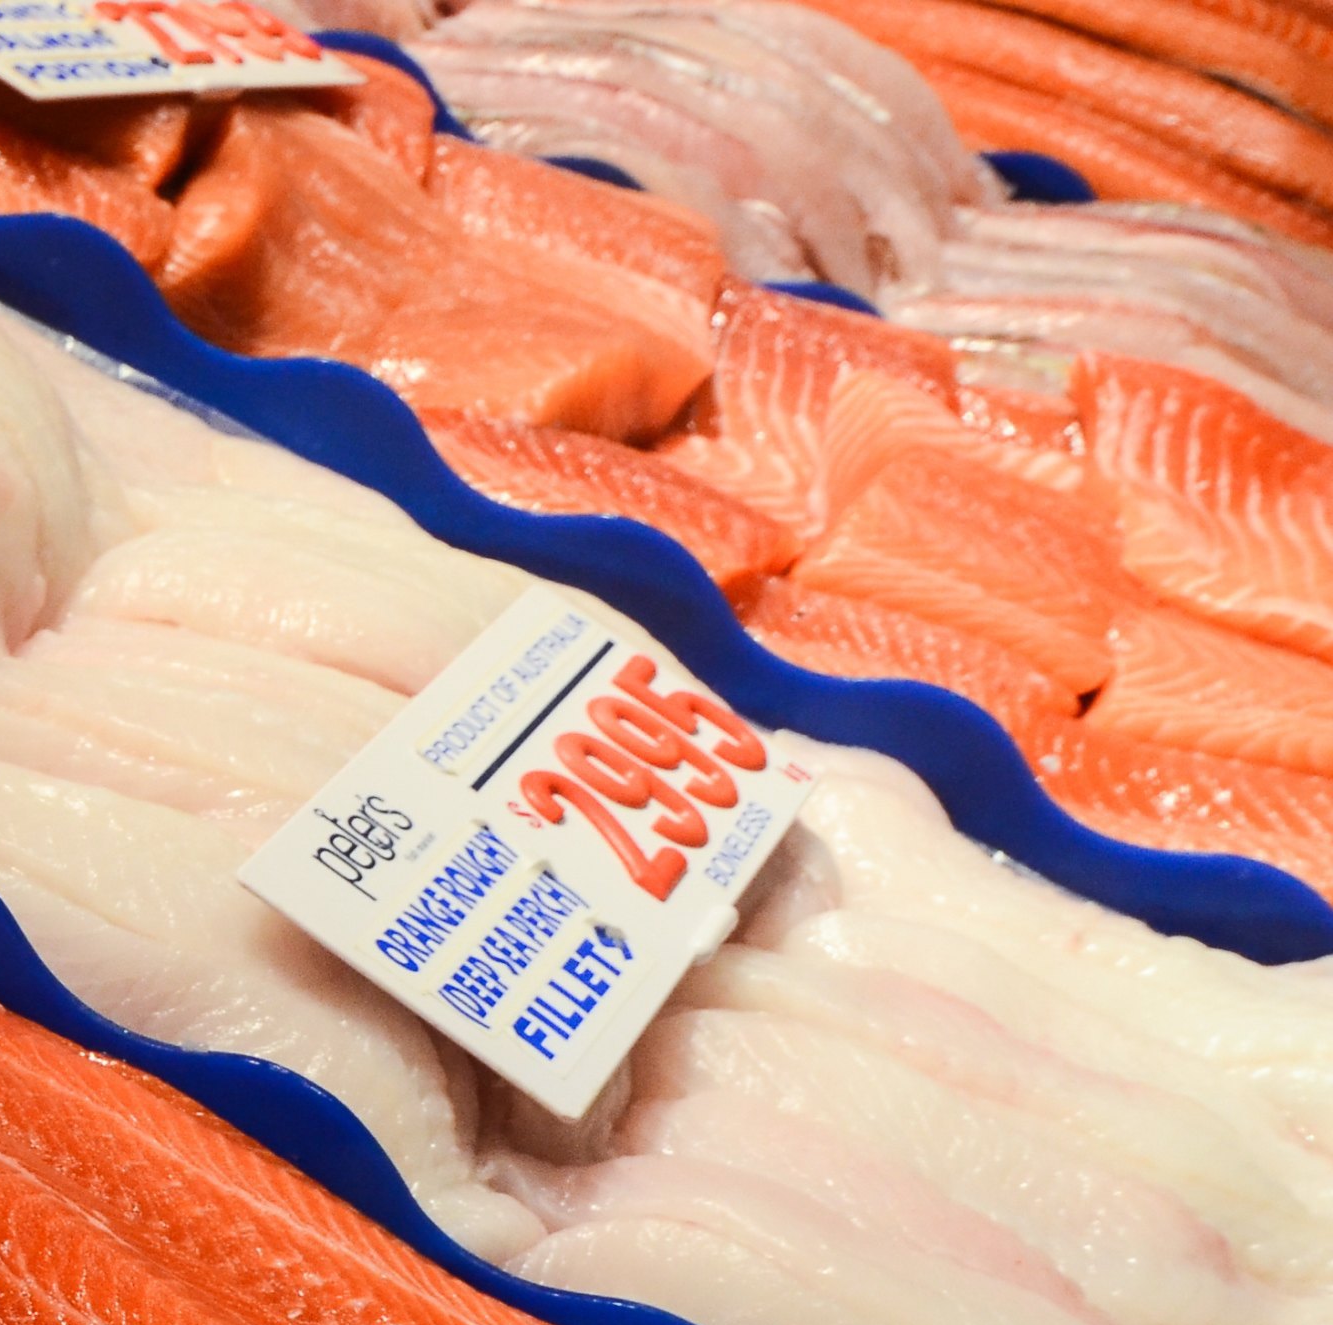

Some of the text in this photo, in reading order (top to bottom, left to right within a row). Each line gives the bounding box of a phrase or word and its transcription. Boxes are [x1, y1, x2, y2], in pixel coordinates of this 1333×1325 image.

[424, 613, 587, 768] PRODUCT OF AUSTRALIA
[376, 829, 519, 972] ORANGE ROUGHY
[704, 801, 773, 888] BONELESS
[437, 956, 508, 1029] (DEEP
[479, 926, 539, 976] SEA
[513, 925, 634, 1061] FILLETS
